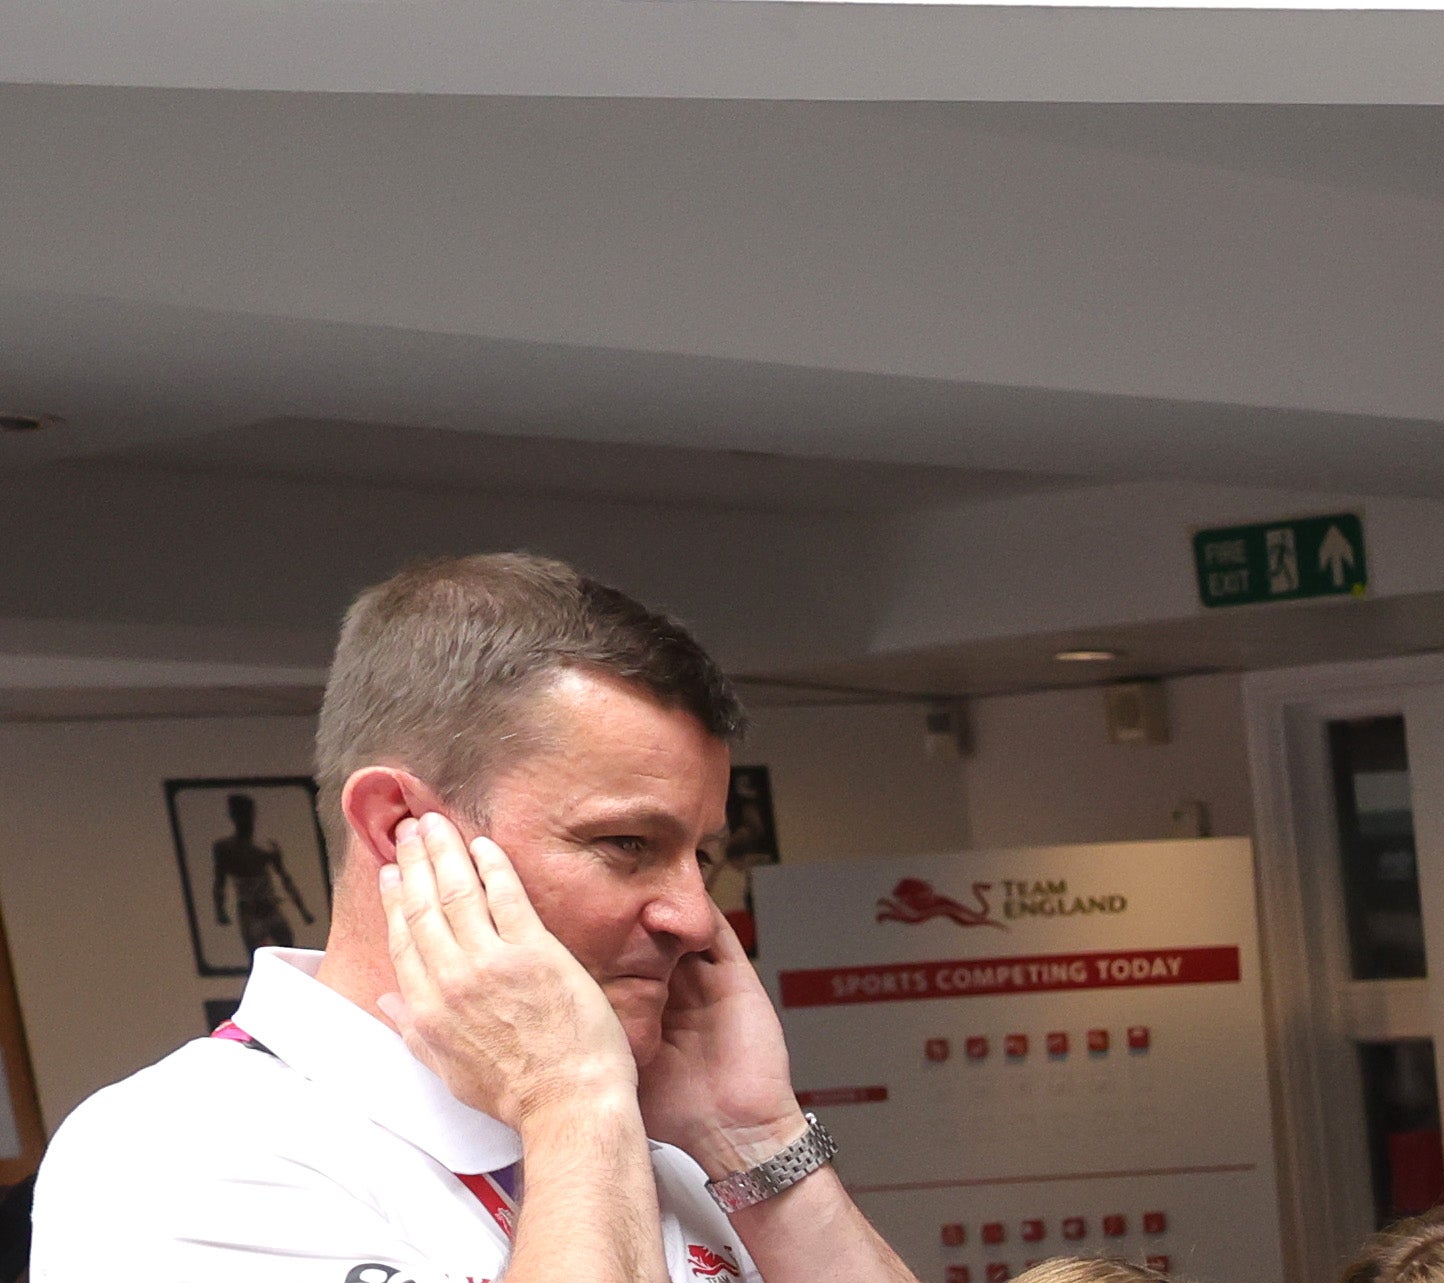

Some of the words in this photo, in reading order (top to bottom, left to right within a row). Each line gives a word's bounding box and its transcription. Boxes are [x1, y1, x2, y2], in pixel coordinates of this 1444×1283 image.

[1204, 539, 1247, 563] FIRE
[1208, 568, 1249, 596] EXIT
[1004, 880, 1068, 898] TEAM
[1003, 895, 1127, 920] ENGLAND
[832, 970, 928, 997] SPORTS
[934, 962, 1088, 990] COMPETING
[1096, 956, 1183, 980] TODAY
